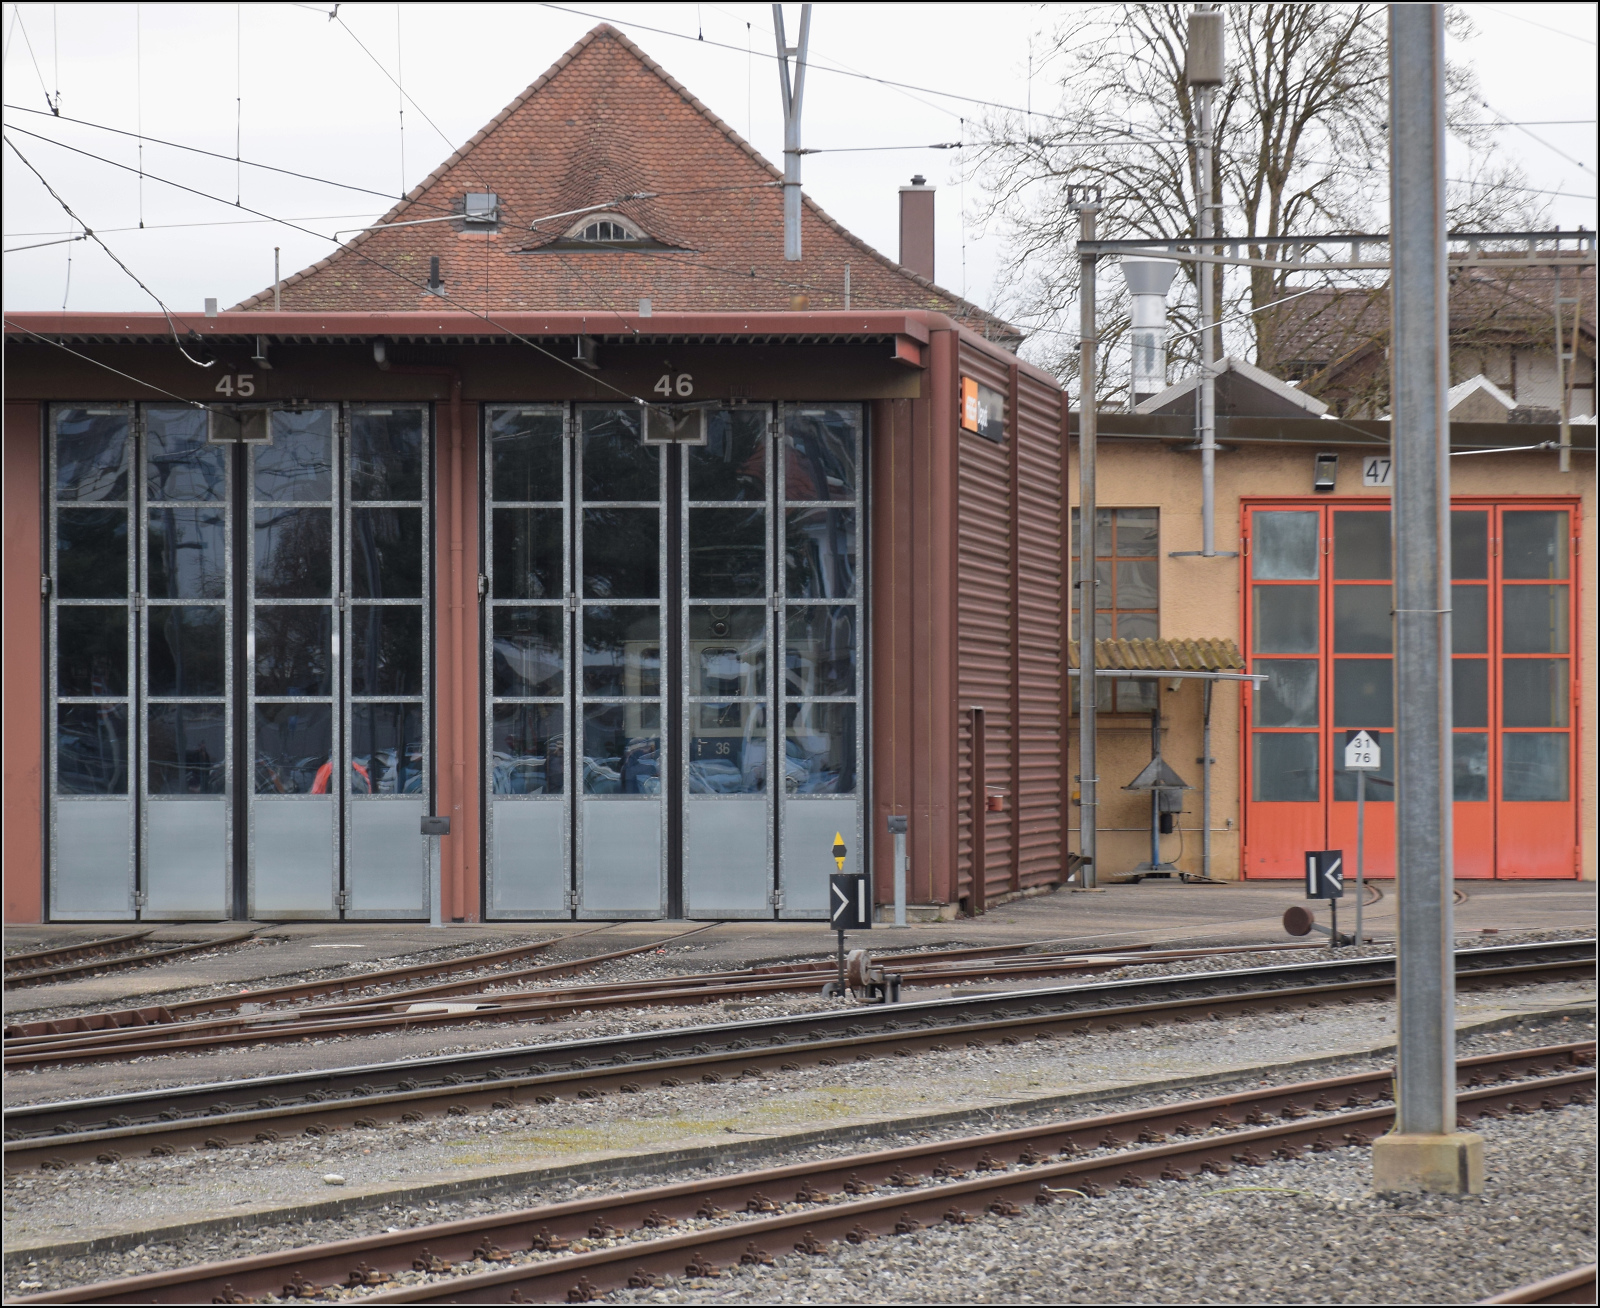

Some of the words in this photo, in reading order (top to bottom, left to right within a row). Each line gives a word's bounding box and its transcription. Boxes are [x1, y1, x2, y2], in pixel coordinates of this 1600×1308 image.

[215, 374, 255, 397] 45
[653, 373, 694, 397] 46
[1366, 460, 1391, 483] 47
[715, 742, 730, 755] 36
[1354, 738, 1370, 748] 31
[1354, 752, 1371, 763] 76
